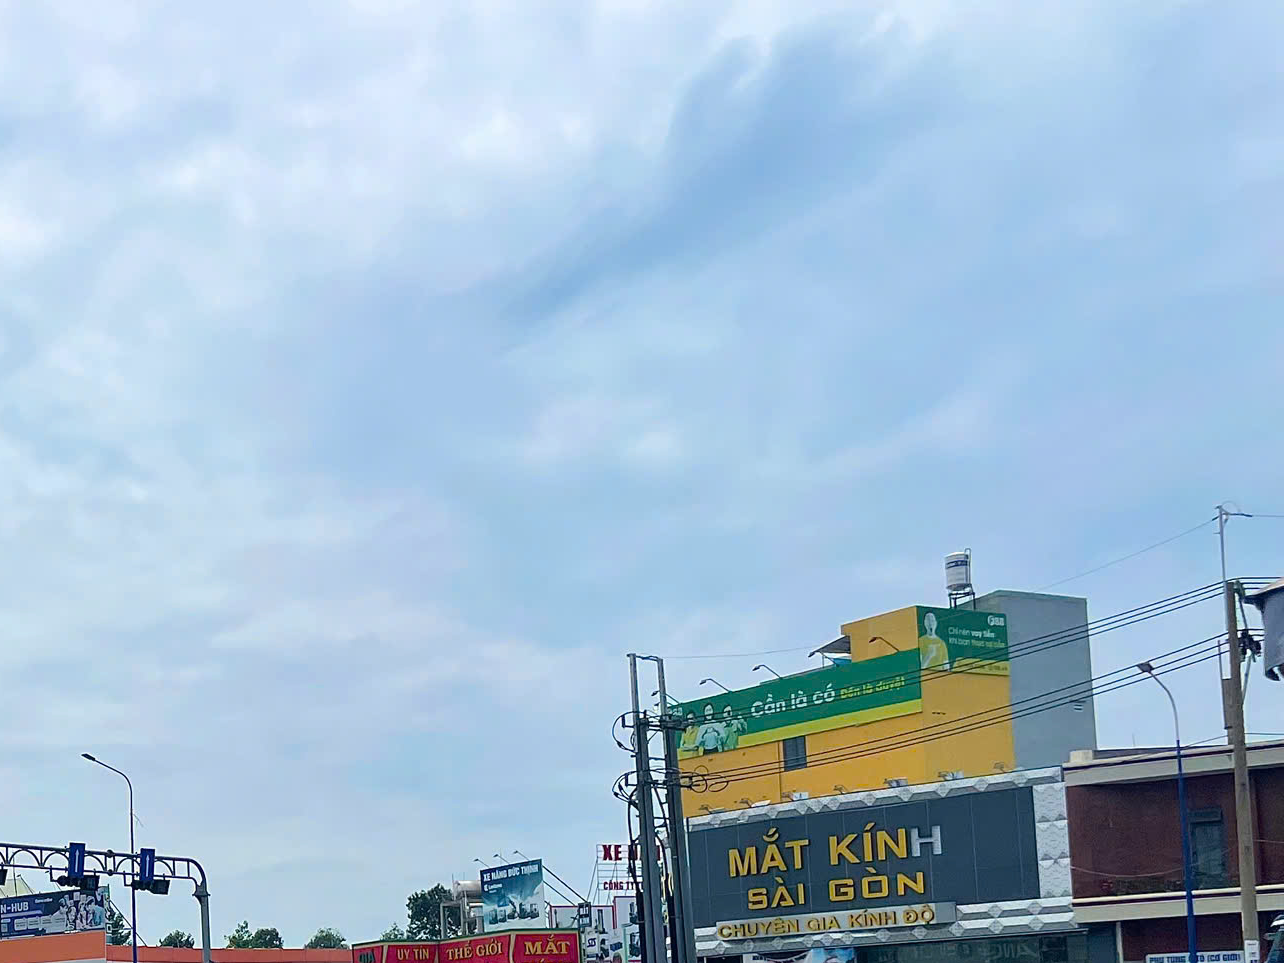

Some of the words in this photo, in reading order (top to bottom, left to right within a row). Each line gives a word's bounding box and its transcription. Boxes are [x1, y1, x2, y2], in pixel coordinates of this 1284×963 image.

[751, 693, 786, 718] Cần
[791, 690, 807, 709] là
[812, 683, 835, 705] có
[602, 844, 622, 861] XE
[728, 827, 809, 877] MẮT
[828, 822, 942, 866] KÍNH
[747, 877, 805, 910] SÀI
[828, 867, 925, 902] GÒN
[0, 901, 28, 914] N-HUB
[718, 918, 799, 938] CHUYÊN
[806, 915, 841, 932] GIA
[847, 909, 896, 930] KÍNH
[902, 905, 934, 926] ĐỘ
[397, 949, 410, 960] UY
[413, 946, 429, 960] TÍN
[446, 941, 473, 961] THẾ
[476, 938, 502, 957] GIỚI
[524, 934, 571, 956] MẮT
